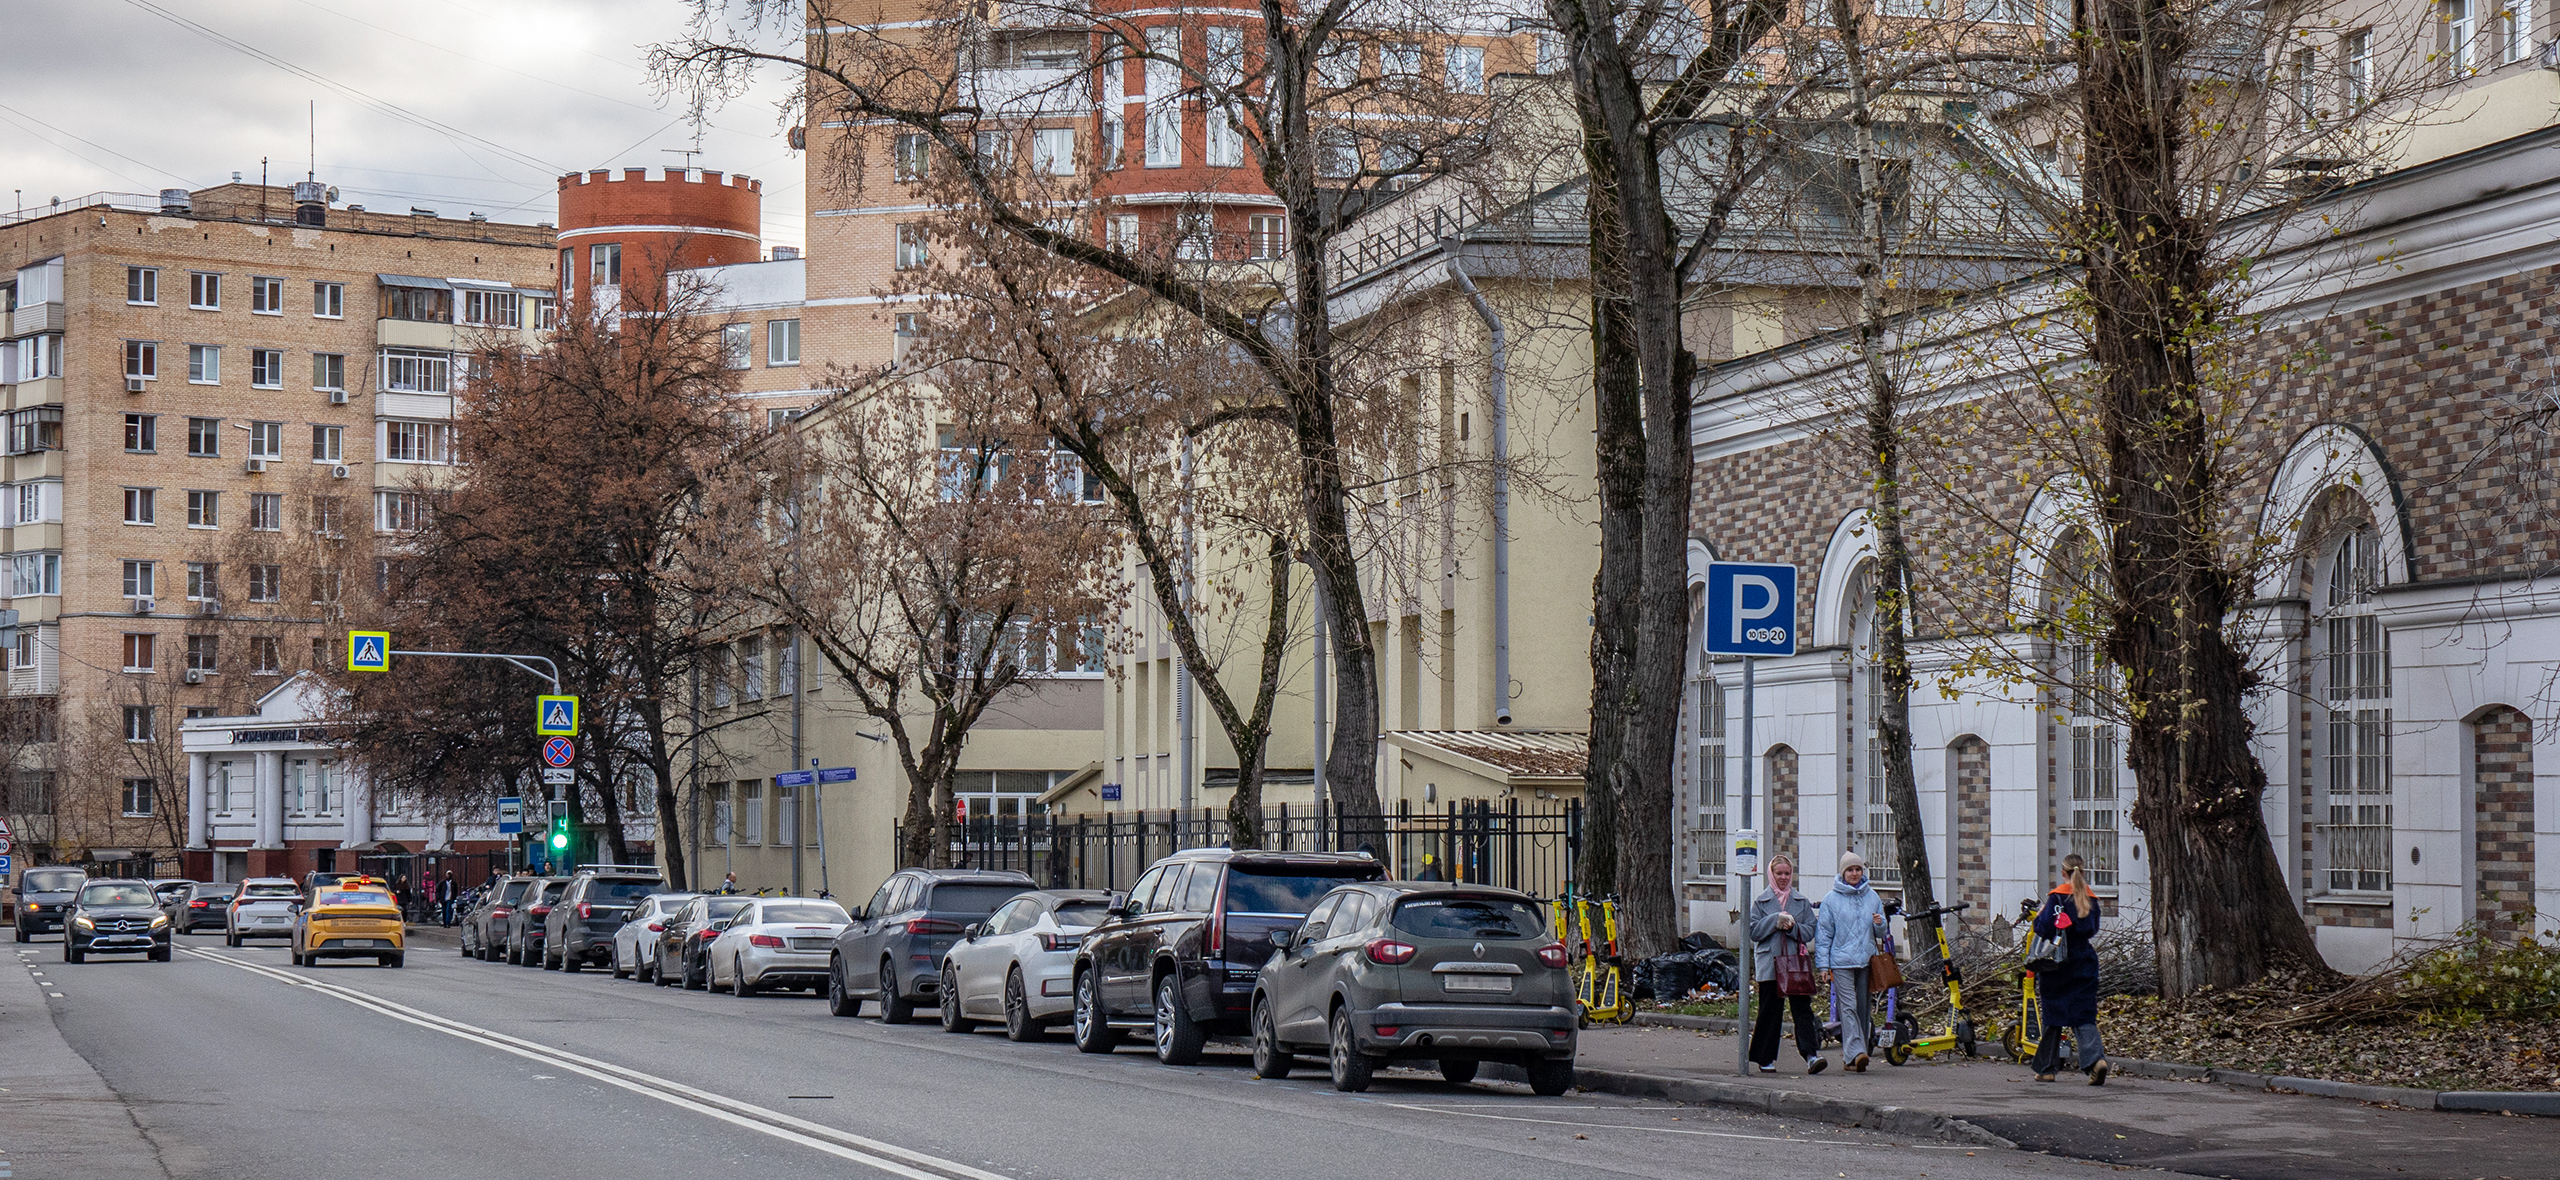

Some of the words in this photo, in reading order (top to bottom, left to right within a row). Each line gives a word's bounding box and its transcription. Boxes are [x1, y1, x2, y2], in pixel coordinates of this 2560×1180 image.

[1731, 573, 1780, 644] P
[1748, 631, 1757, 639] 10
[1758, 630, 1768, 640] 15
[1770, 630, 1785, 641] 20
[558, 819, 567, 832] 4
